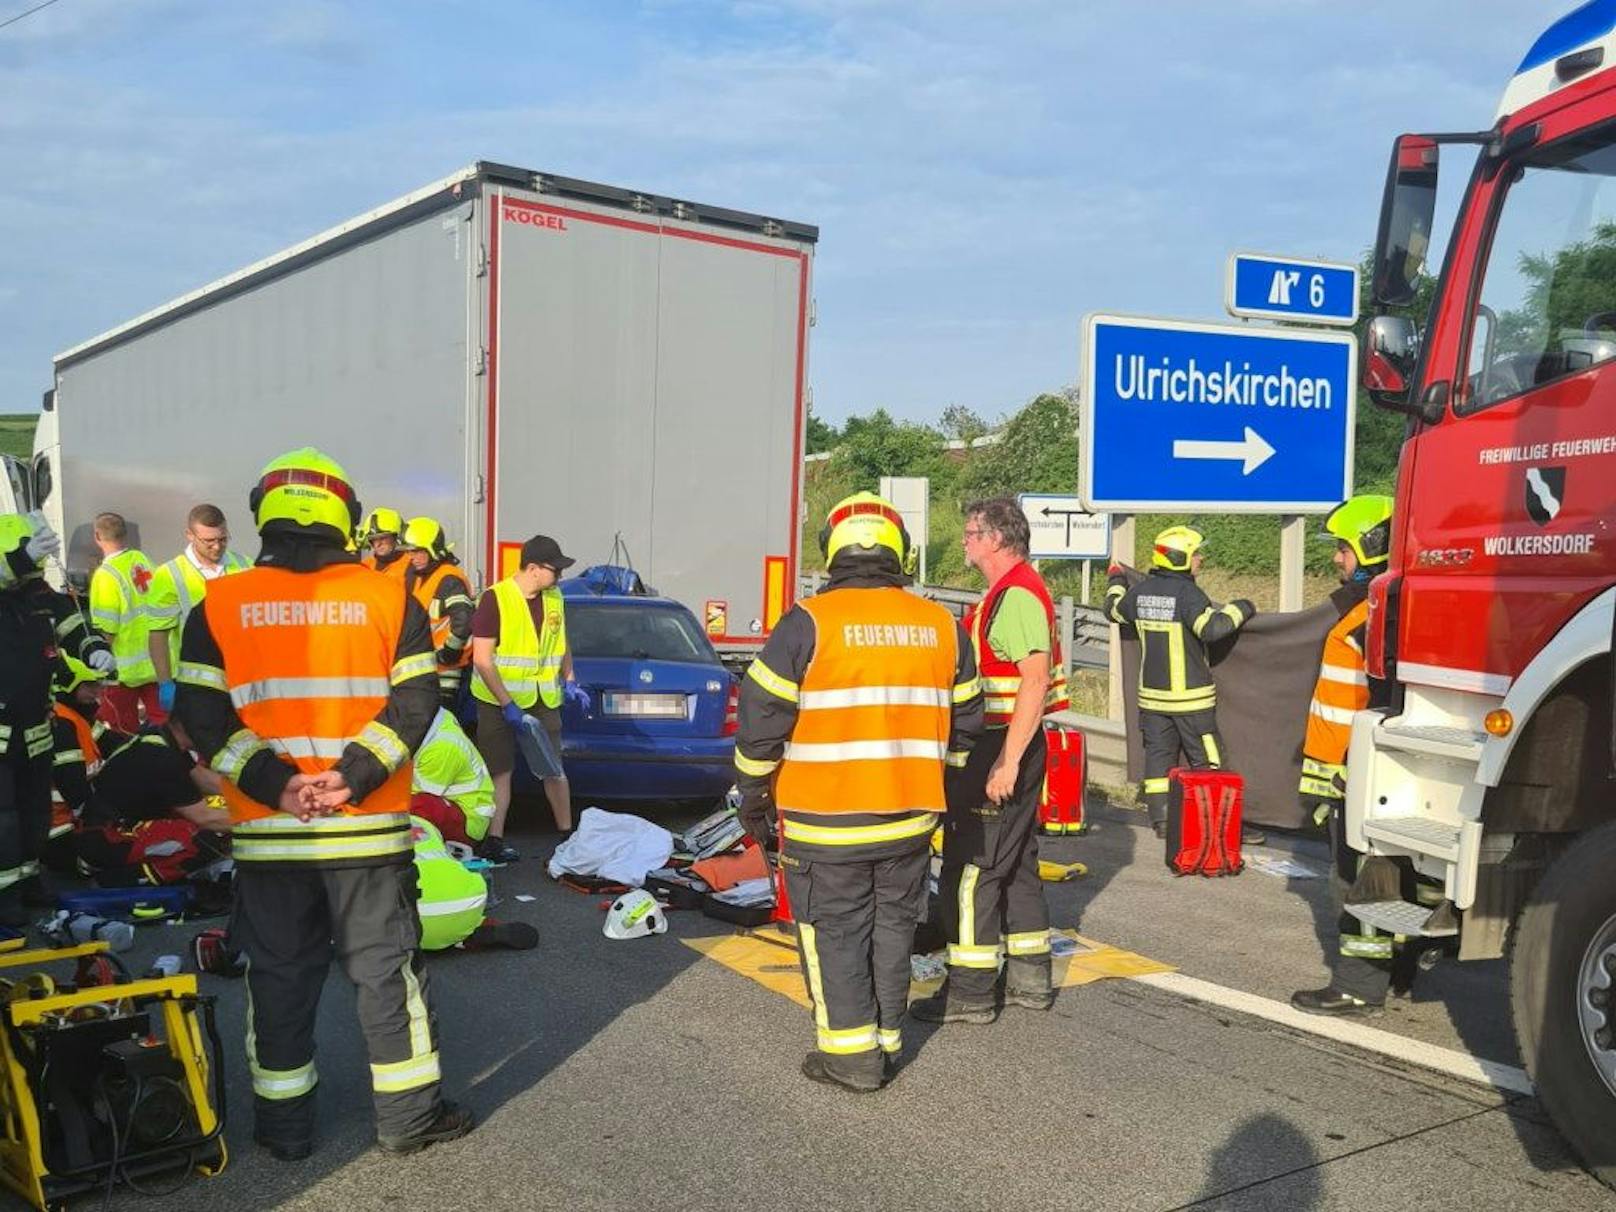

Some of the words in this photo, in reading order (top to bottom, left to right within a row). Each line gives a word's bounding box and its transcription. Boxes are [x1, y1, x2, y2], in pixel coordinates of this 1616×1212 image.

[1310, 274, 1325, 308] 6
[1115, 353, 1332, 410] Ulrichskirchen
[1479, 443, 1550, 465] FREIWILLIGE
[1484, 534, 1595, 556] WOLKERSDORF
[240, 600, 368, 628] FEUERWEHR
[843, 623, 938, 649] FEUERWEHR
